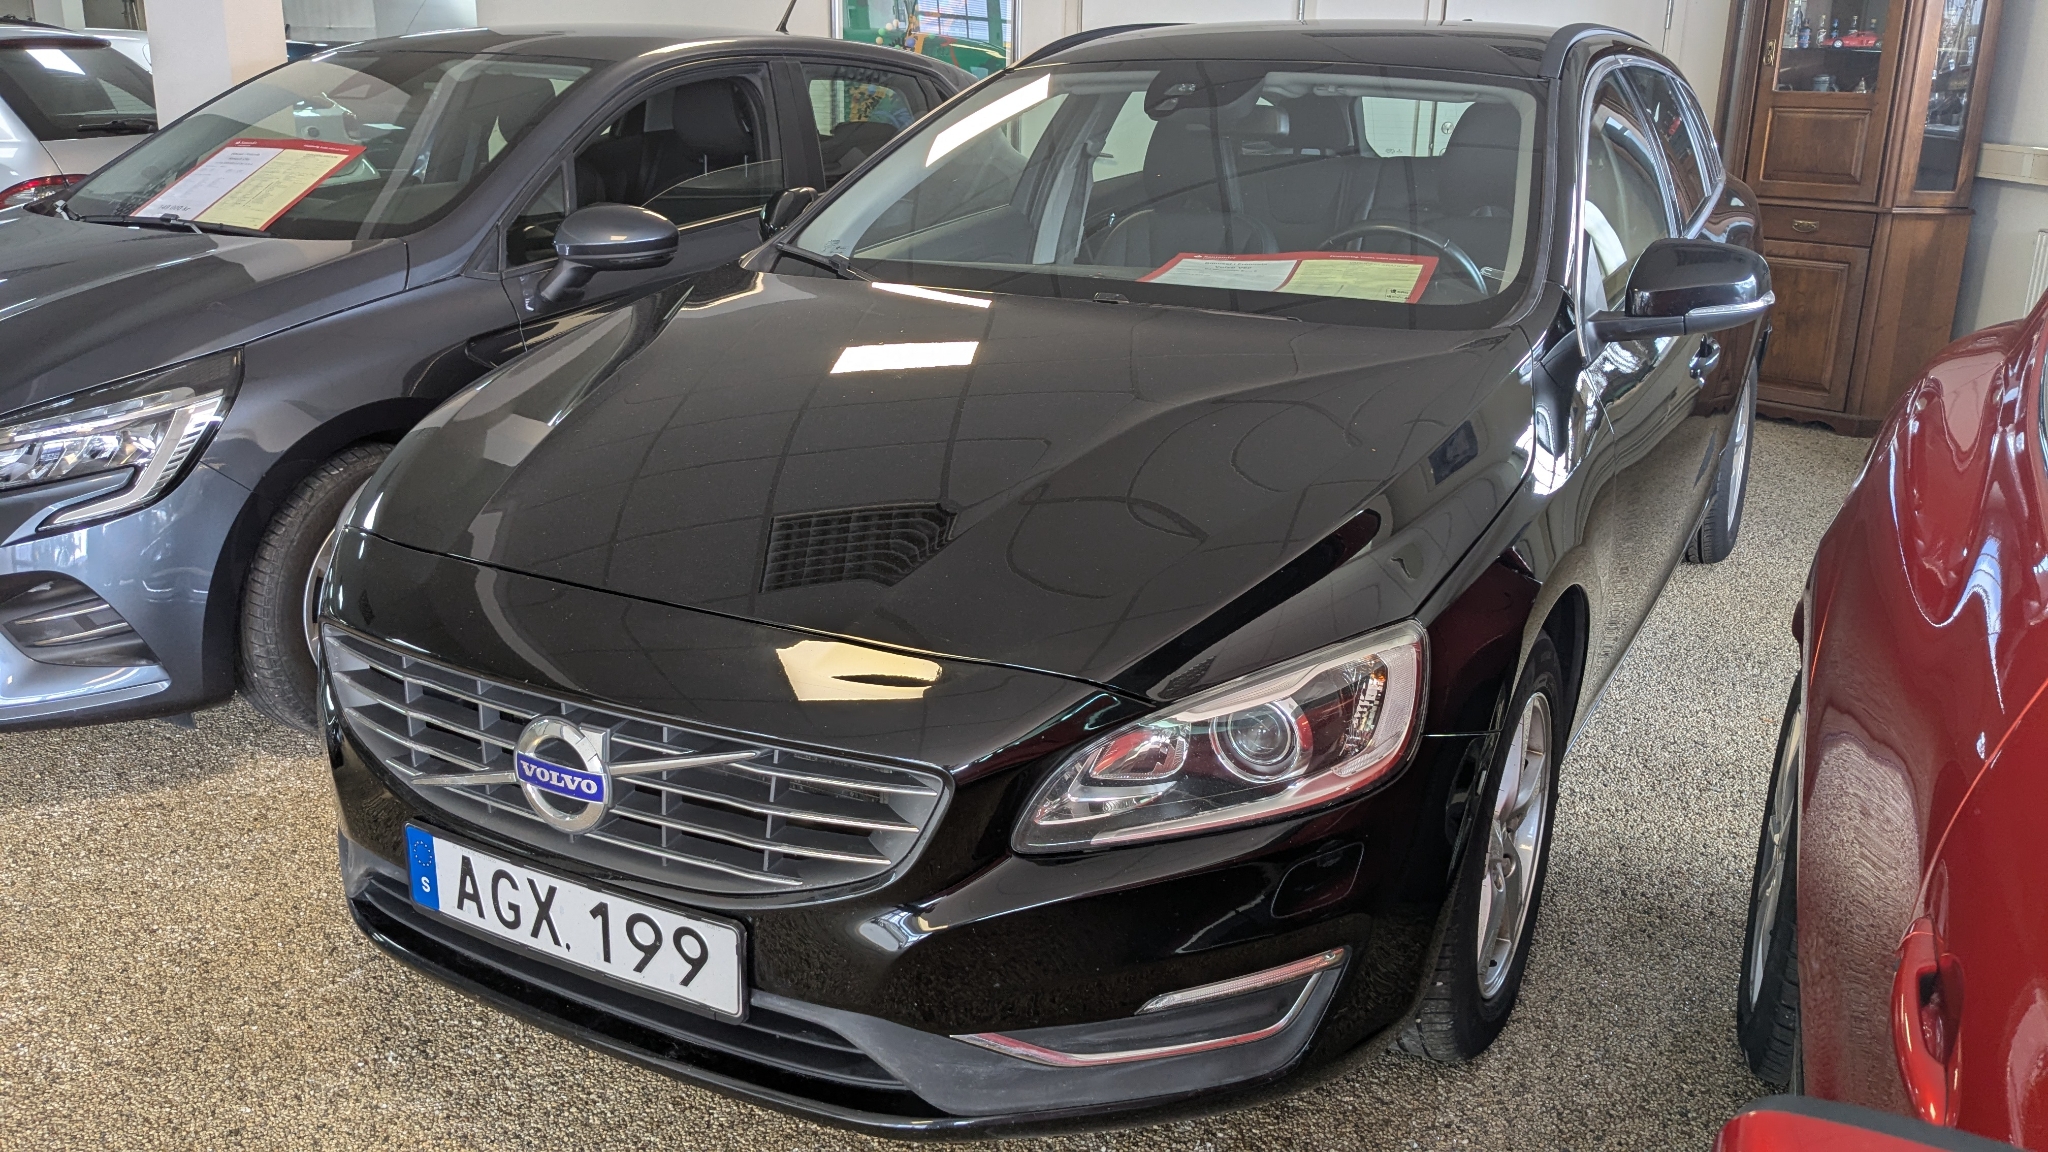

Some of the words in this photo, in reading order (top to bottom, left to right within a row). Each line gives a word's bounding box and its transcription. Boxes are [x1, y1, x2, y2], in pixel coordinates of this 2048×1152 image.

[520, 760, 598, 795] VOLVO
[420, 876, 431, 893] S
[589, 901, 709, 988] 199
